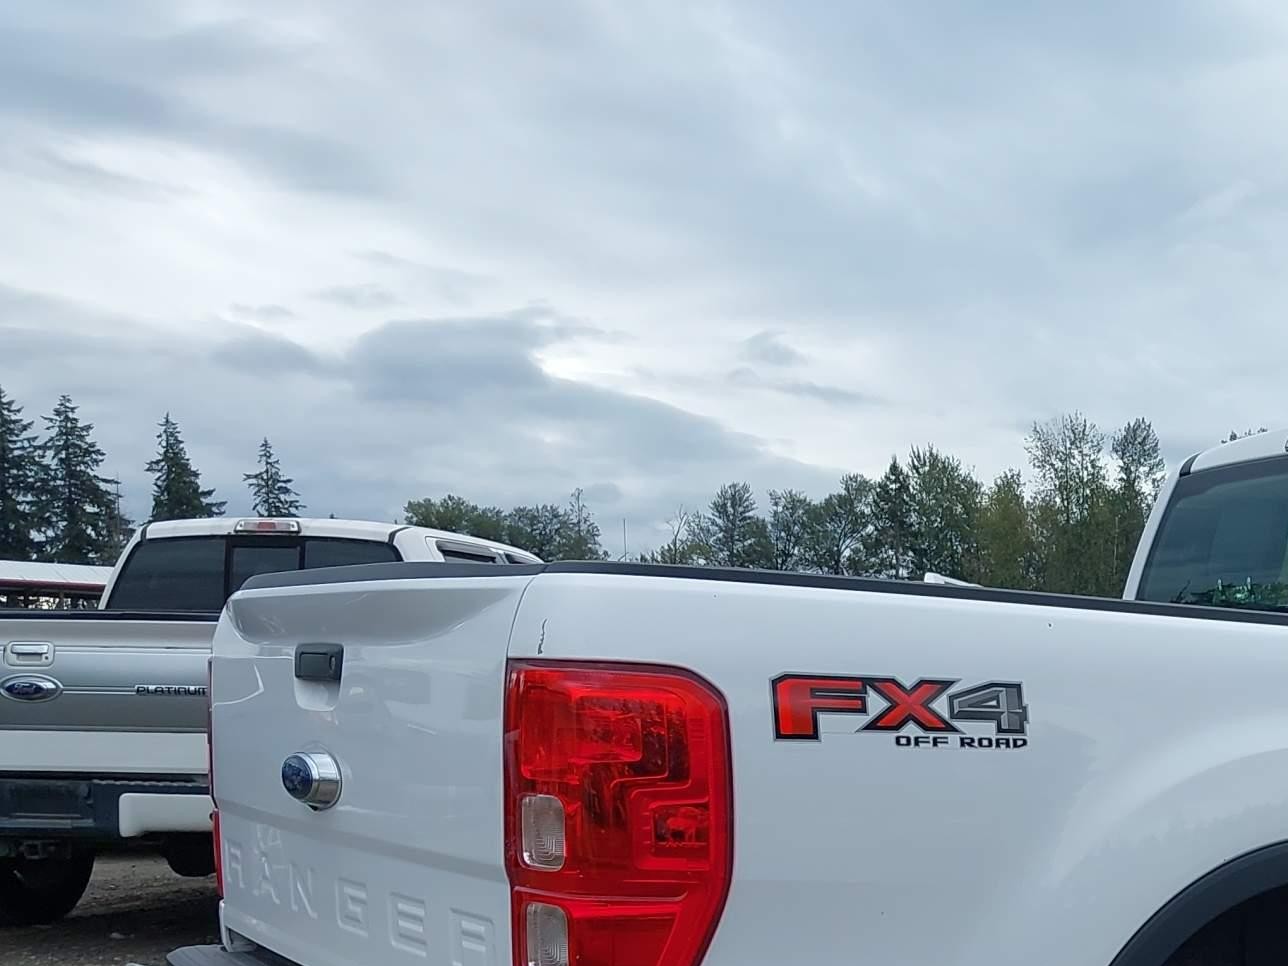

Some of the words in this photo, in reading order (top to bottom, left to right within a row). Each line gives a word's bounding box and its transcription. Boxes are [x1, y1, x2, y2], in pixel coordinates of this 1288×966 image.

[769, 672, 1029, 742] FX4
[895, 735, 948, 747] OFF
[960, 735, 1027, 749] ROAD
